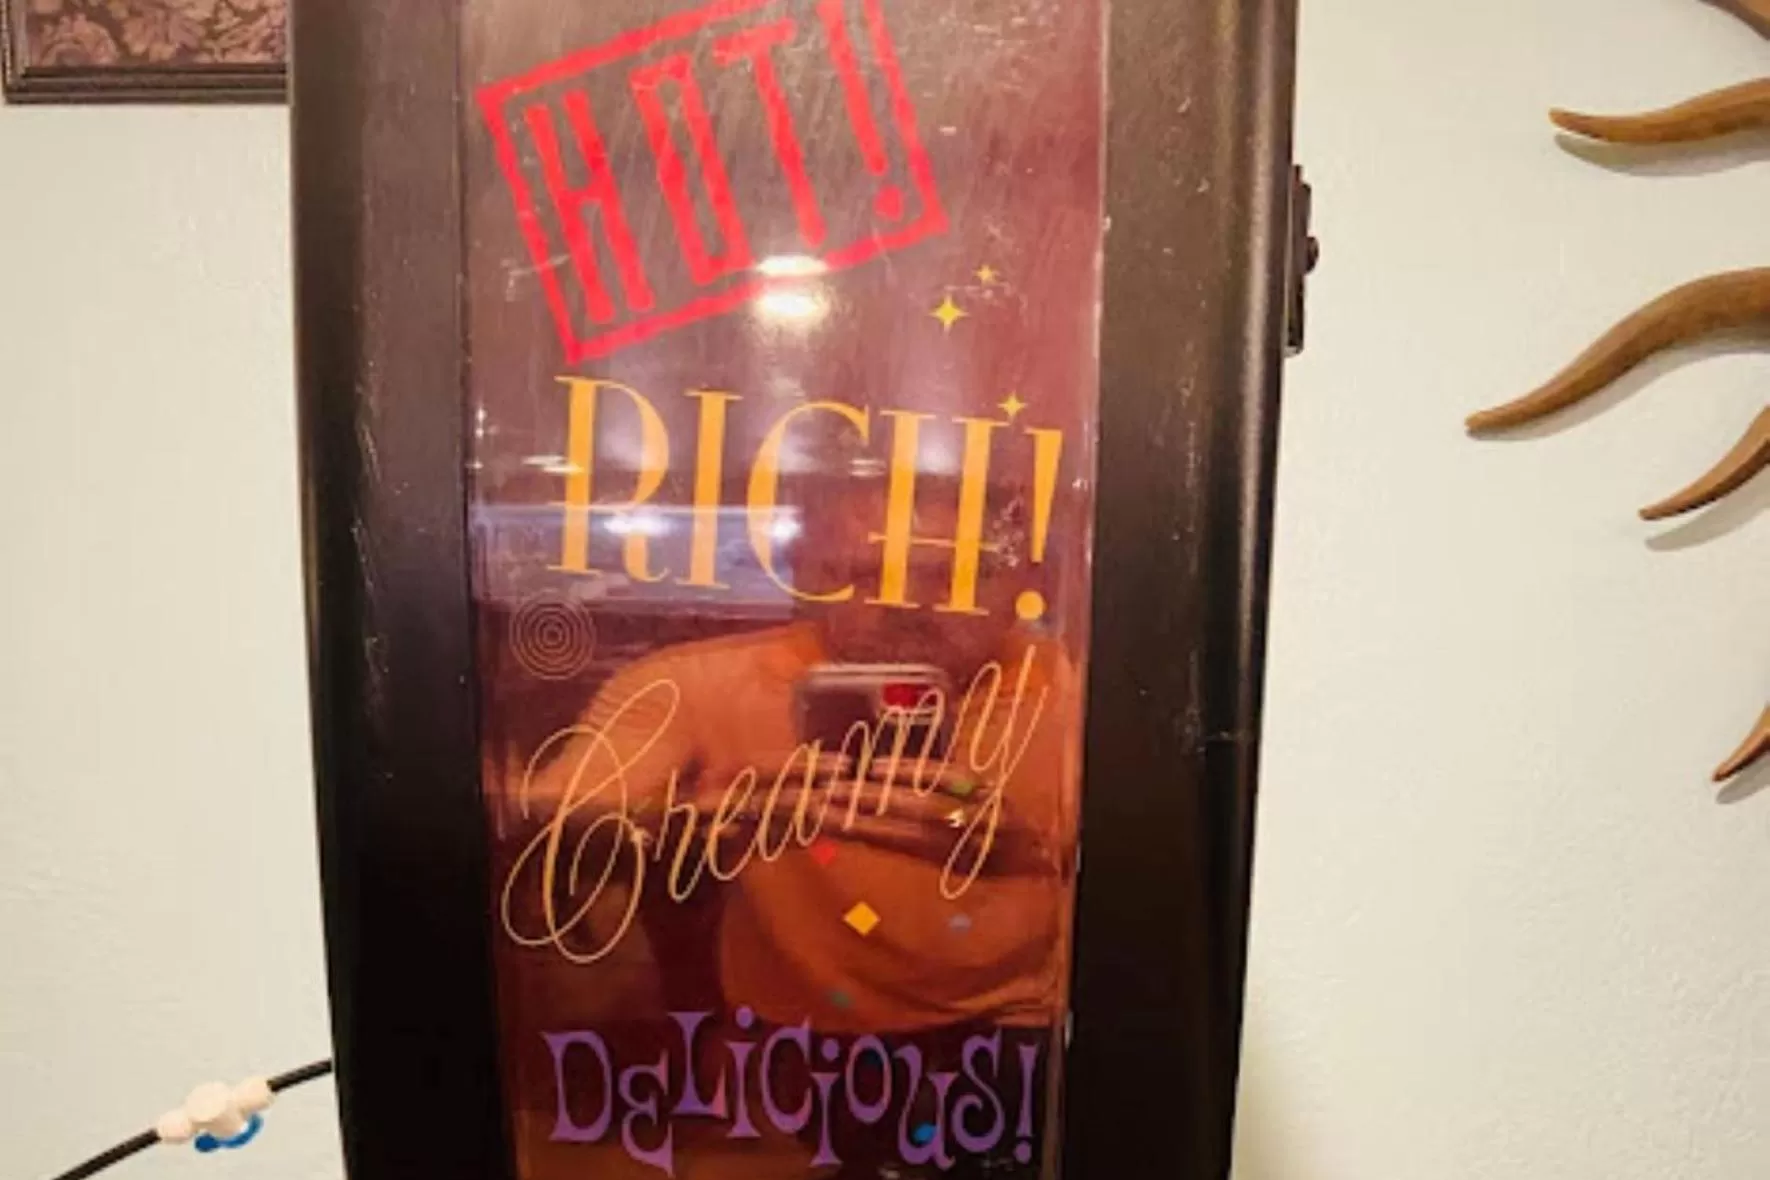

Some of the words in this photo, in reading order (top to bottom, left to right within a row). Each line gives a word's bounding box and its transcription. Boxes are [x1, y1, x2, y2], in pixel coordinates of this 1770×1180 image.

[525, 0, 905, 323] HOT!
[547, 374, 1063, 621] RICH!
[501, 644, 1049, 963] Creamy
